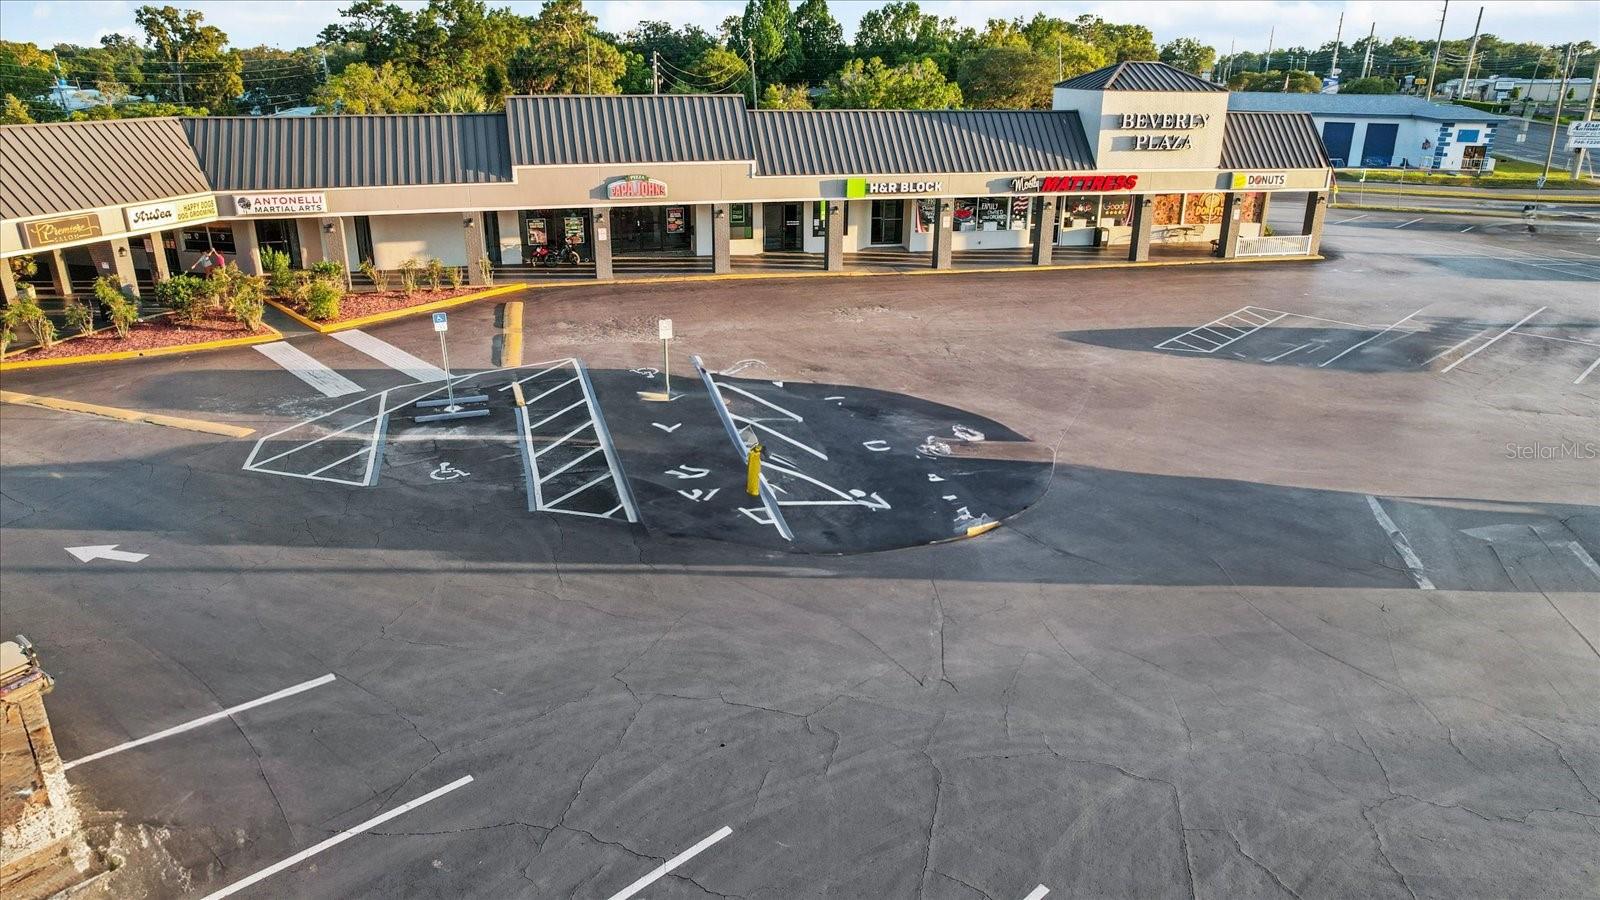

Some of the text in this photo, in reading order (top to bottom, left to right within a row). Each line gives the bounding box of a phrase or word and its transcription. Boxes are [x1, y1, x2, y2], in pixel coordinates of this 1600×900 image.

[1121, 113, 1209, 129] BEVERLY
[1134, 135, 1193, 150] PLAZA
[1041, 175, 1138, 192] MATTRESS
[1248, 175, 1285, 185] DONUTS
[611, 180, 666, 197] PAPA JOHNS
[869, 181, 943, 193] H&R BLOCK
[183, 200, 214, 211] HAPPY DOGS
[254, 196, 322, 206] ANTONELLI
[177, 208, 216, 220] DOG GROOMING
[254, 204, 322, 213] MARTIAL ARTS
